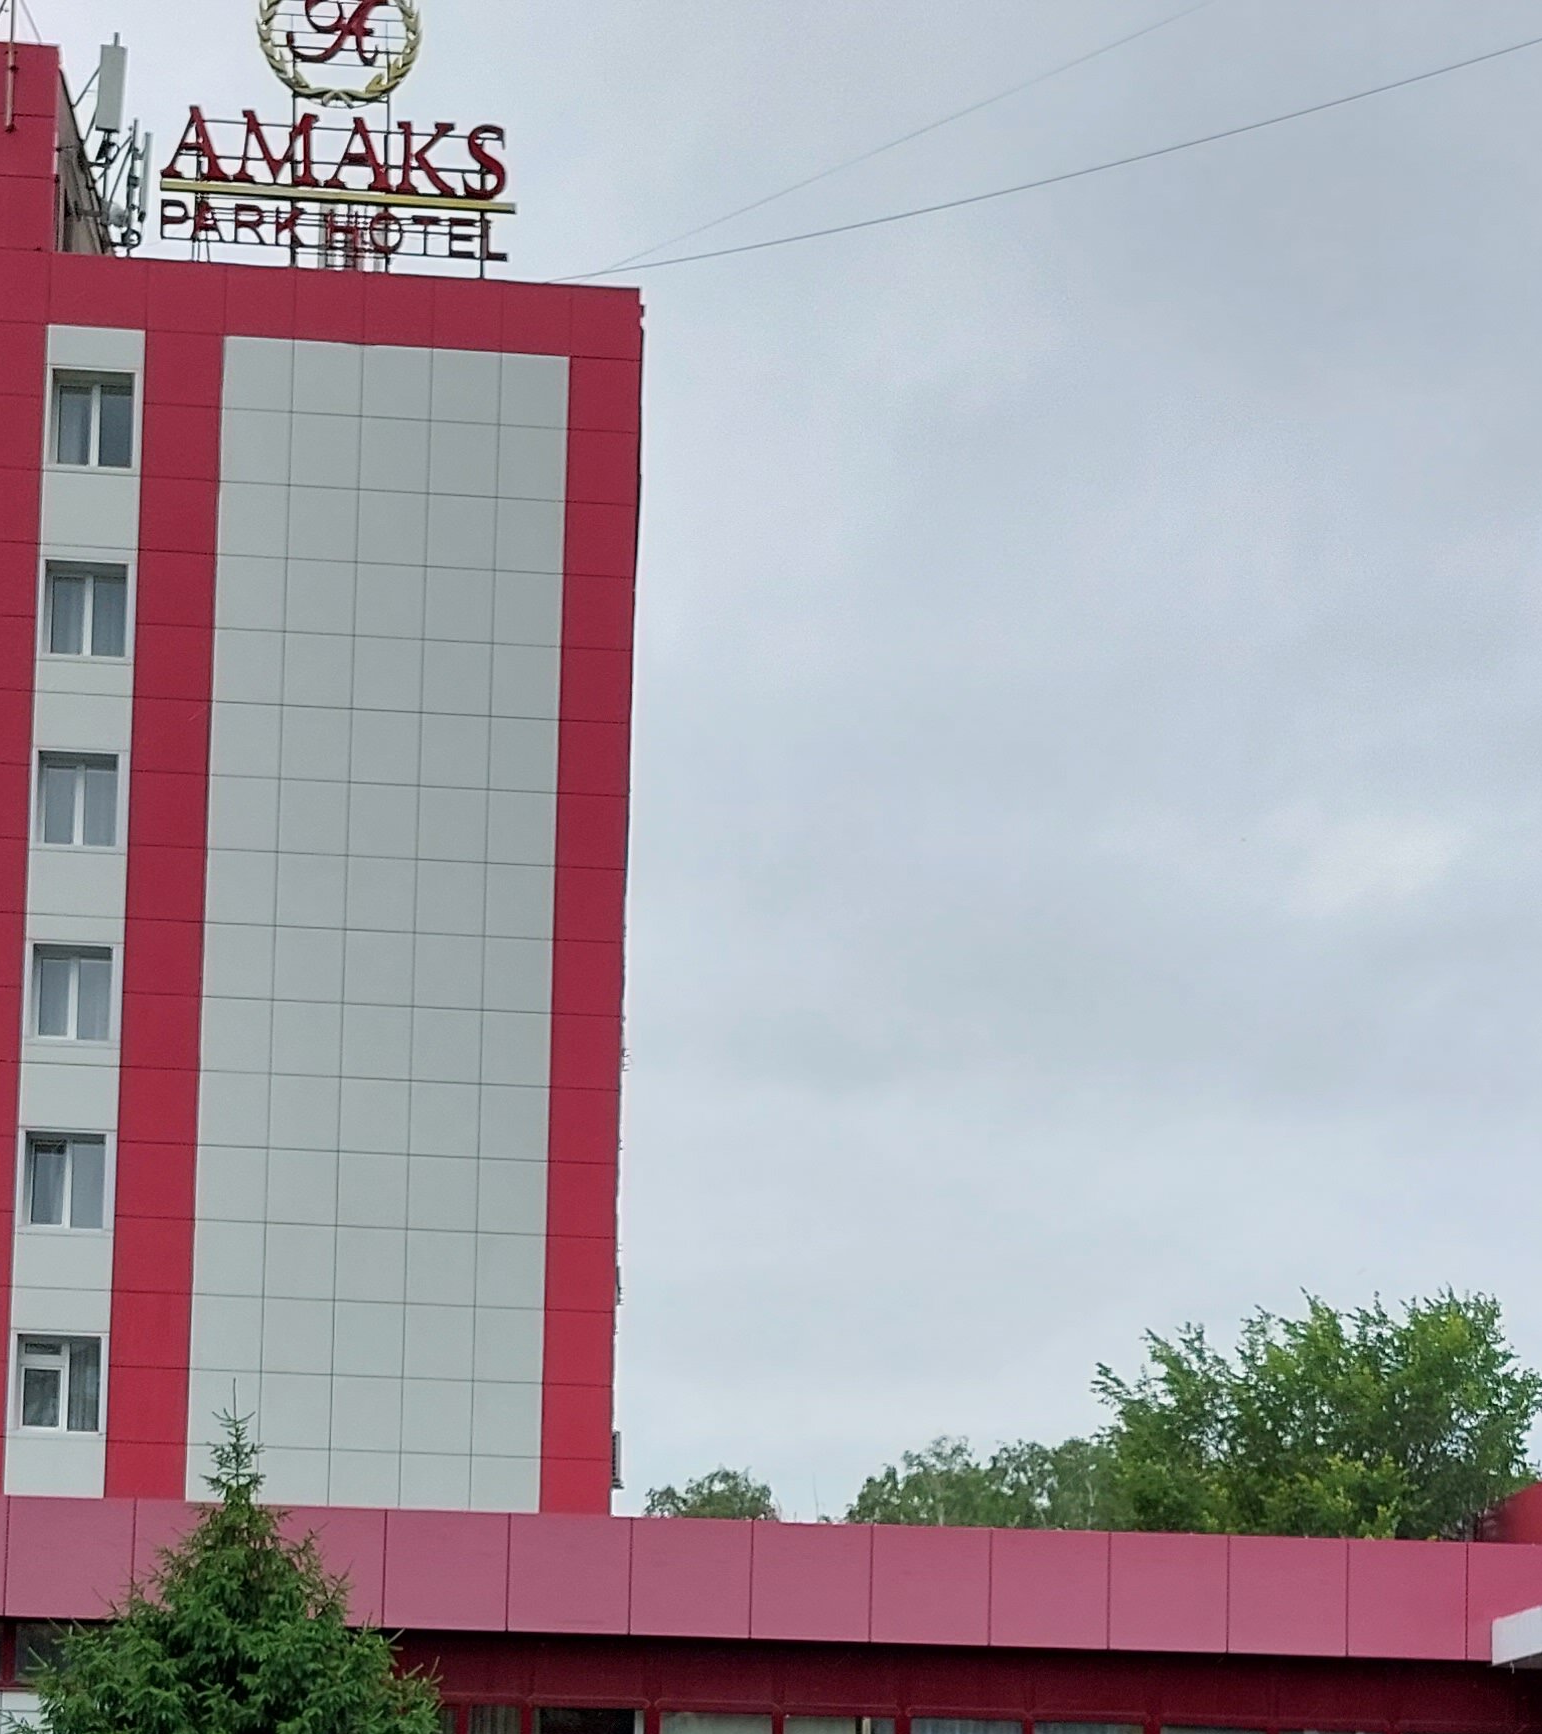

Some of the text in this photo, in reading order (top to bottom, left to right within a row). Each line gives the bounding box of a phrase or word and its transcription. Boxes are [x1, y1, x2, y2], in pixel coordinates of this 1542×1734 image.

[160, 105, 507, 200] AMAKS
[160, 199, 508, 262] PARK HOTEL
